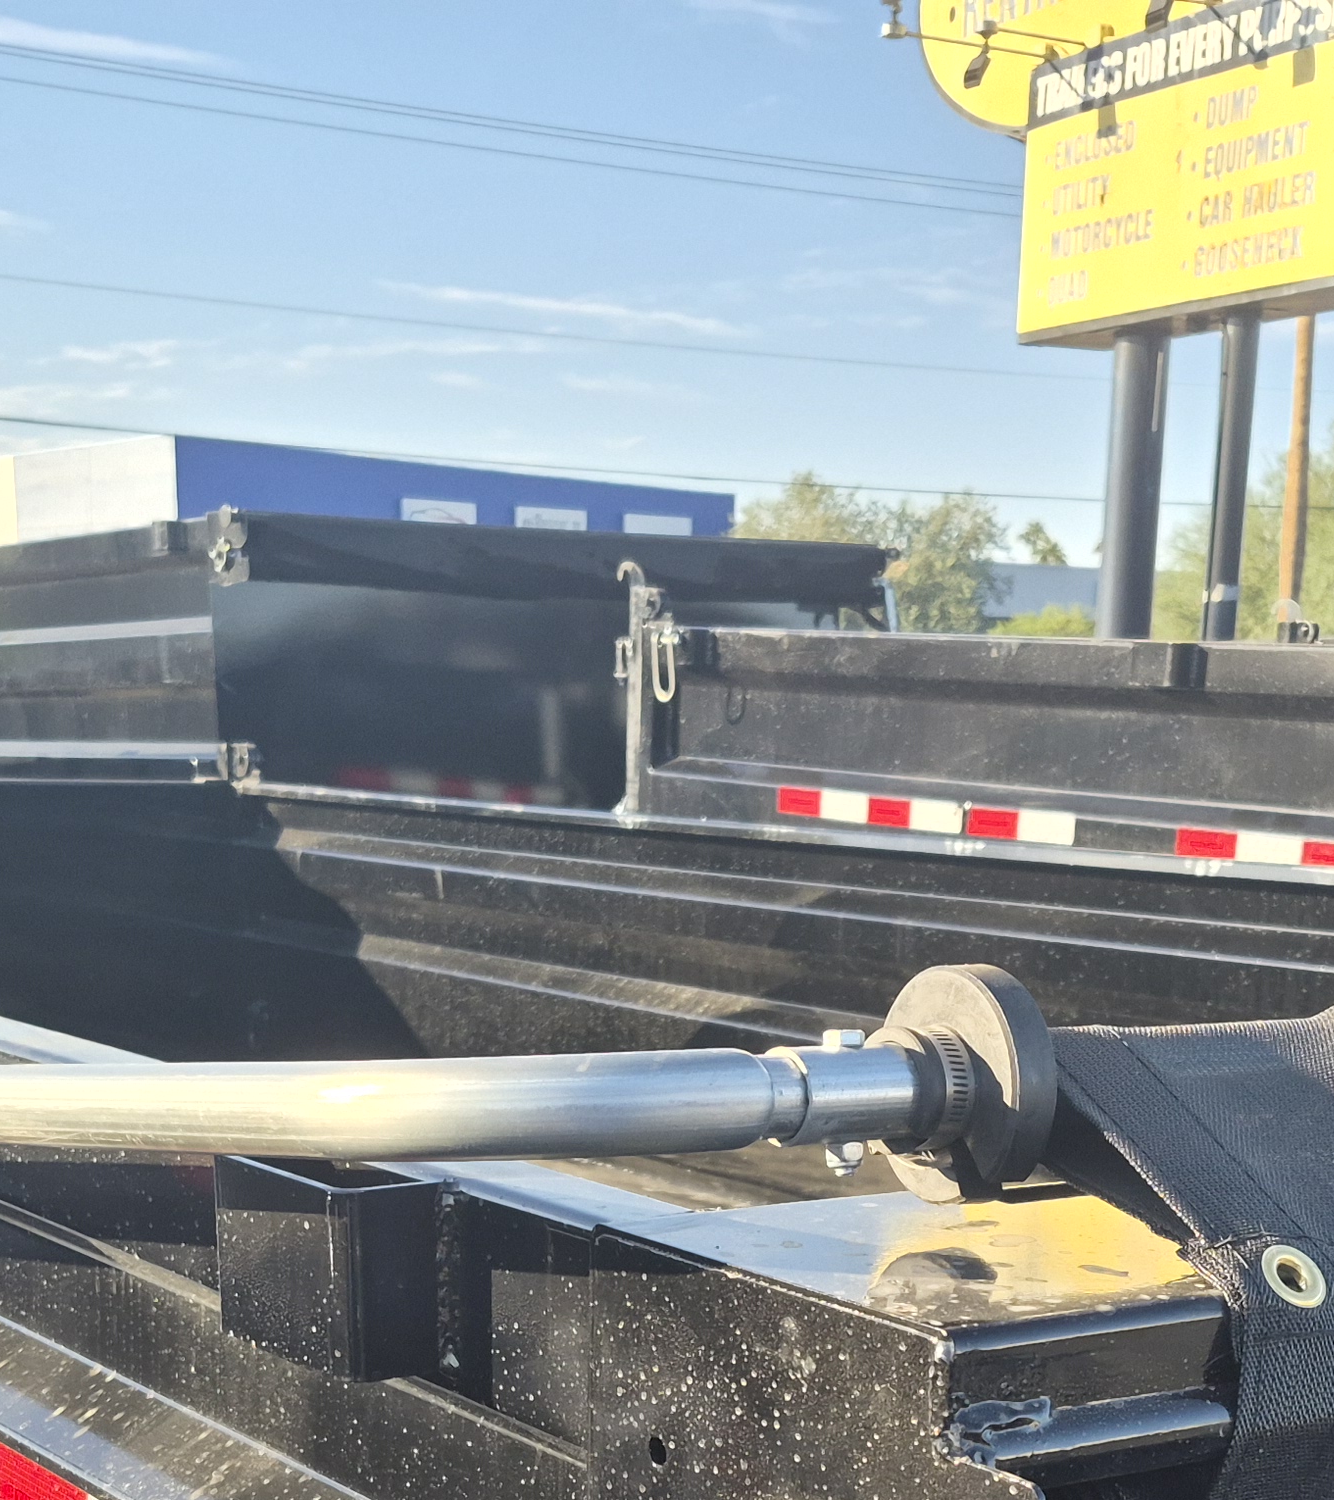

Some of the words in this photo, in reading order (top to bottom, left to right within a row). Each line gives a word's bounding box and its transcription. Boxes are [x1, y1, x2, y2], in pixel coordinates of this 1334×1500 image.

[1124, 39, 1166, 91] FOR
[1167, 17, 1237, 77] EVERY
[1206, 85, 1258, 129] DUMP
[1203, 120, 1310, 182] EQUIPMENT
[1052, 173, 1110, 216] UTILITY
[1199, 190, 1233, 229] CAR
[1242, 171, 1316, 219] HAULER
[1050, 208, 1155, 261] MOTORCYCLE
[1194, 225, 1304, 278] GOOSENECK
